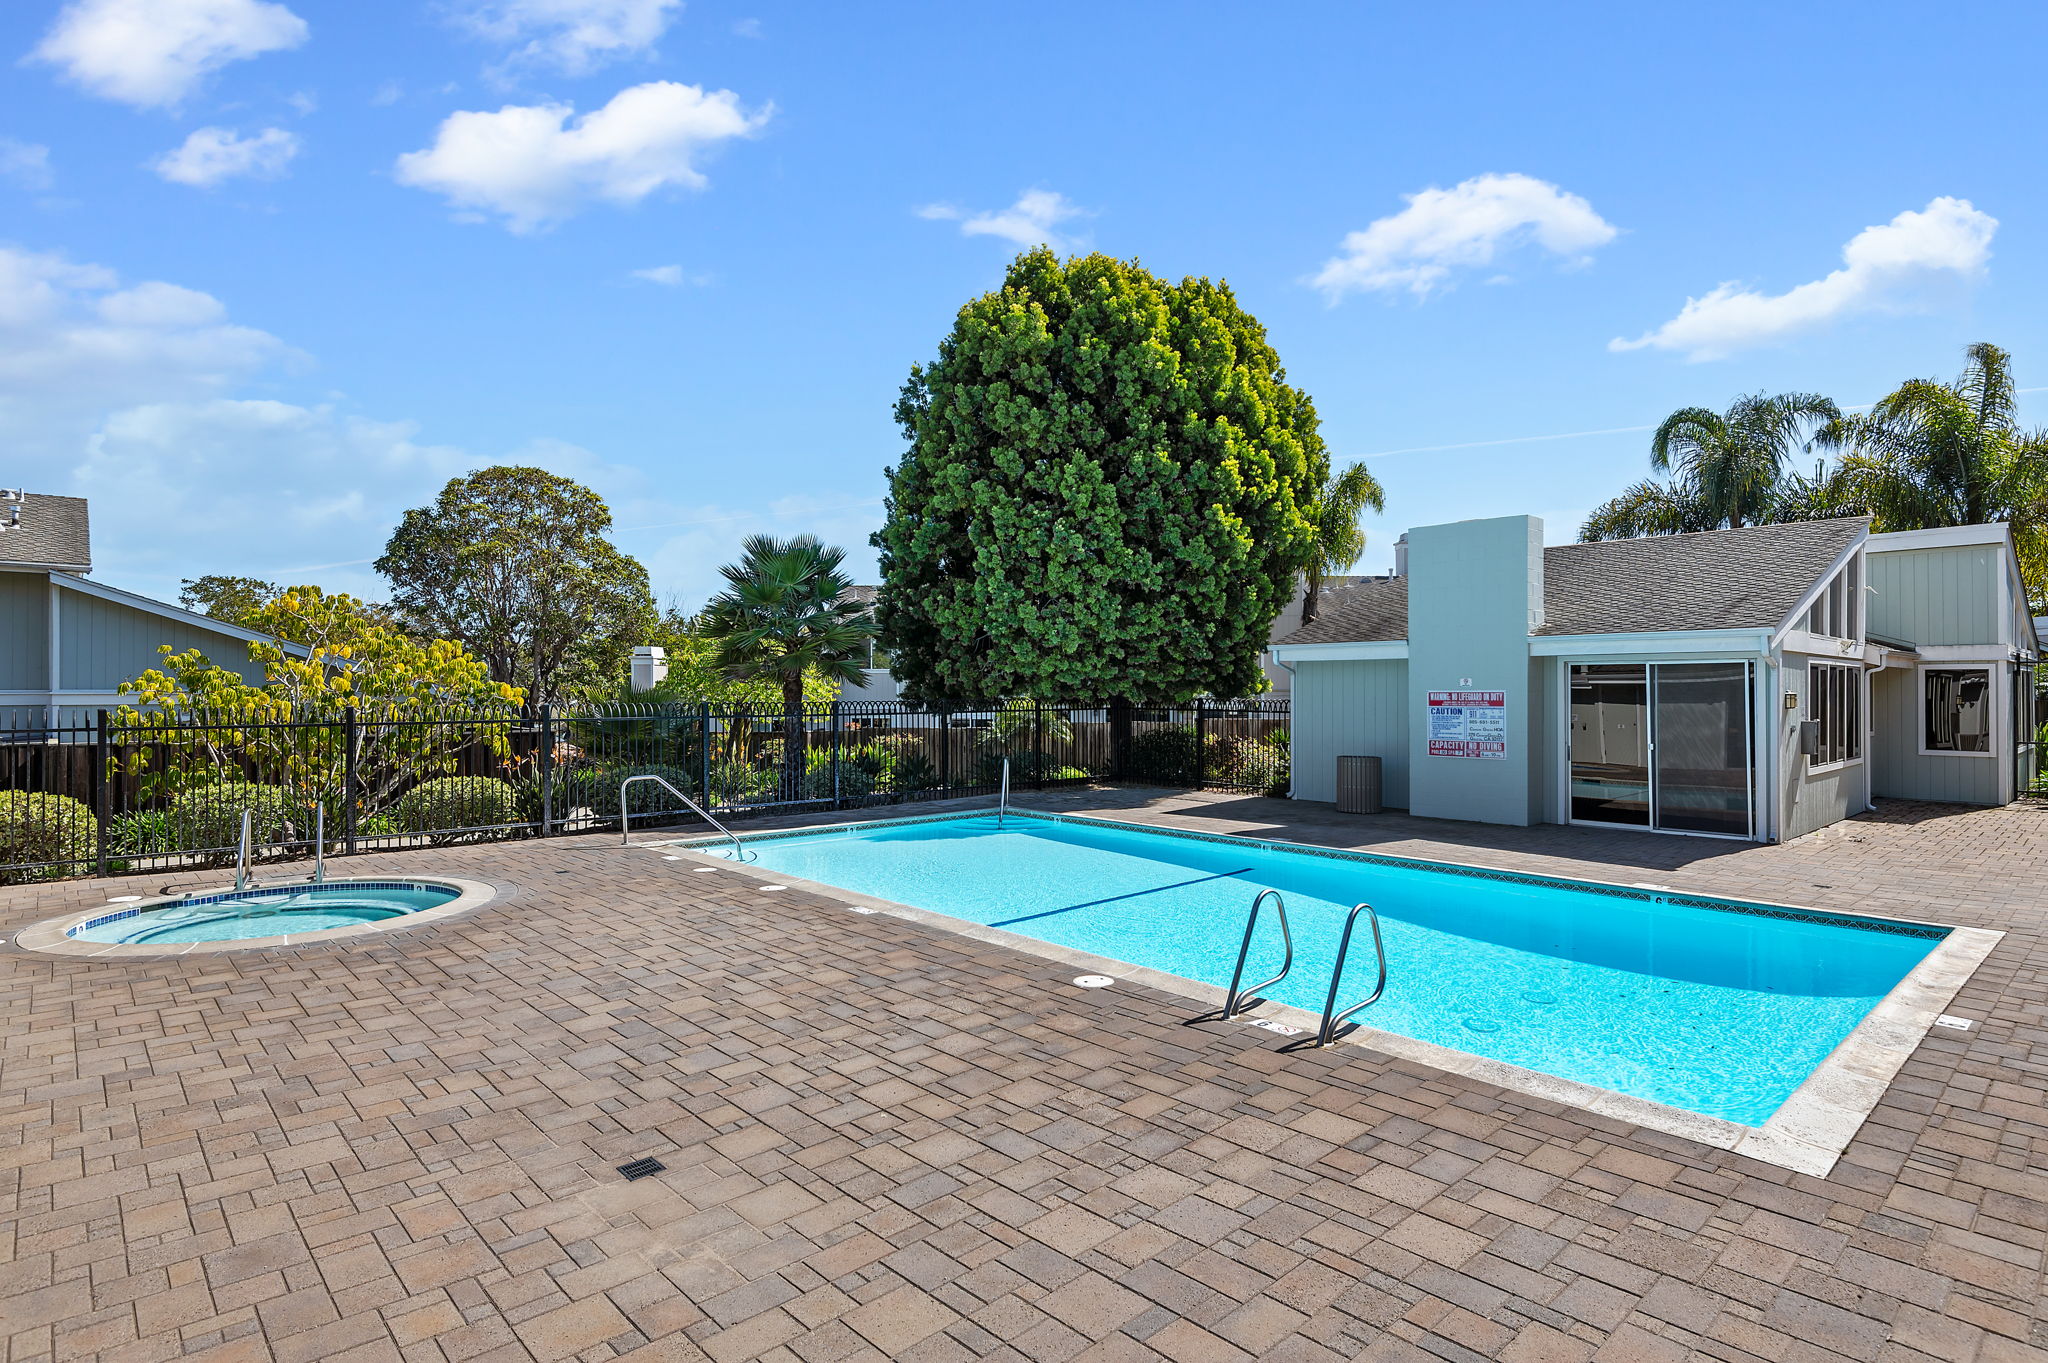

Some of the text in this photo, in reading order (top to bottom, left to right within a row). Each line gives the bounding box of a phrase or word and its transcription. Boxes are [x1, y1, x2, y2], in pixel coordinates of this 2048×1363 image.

[1491, 693, 1503, 701] DUTY
[1430, 741, 1464, 750] CAPACITY
[1469, 742, 1502, 751] NO DIVING
